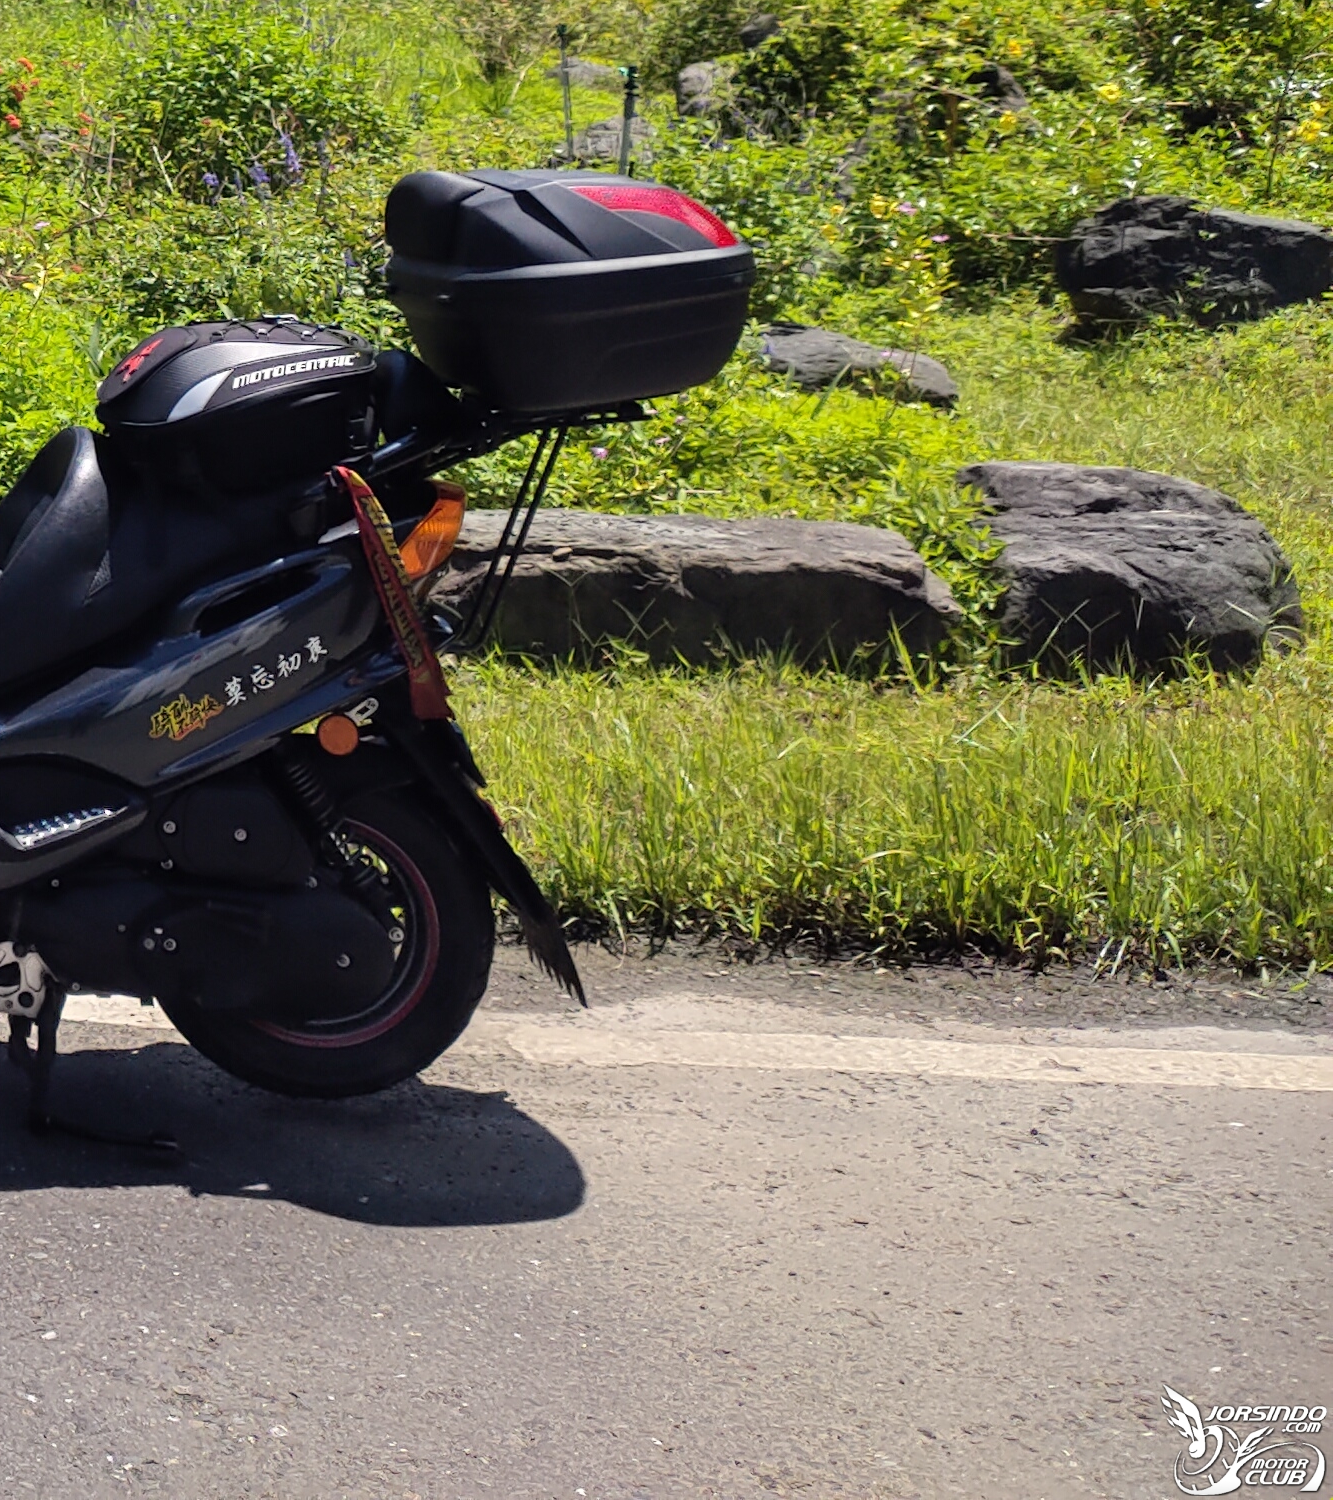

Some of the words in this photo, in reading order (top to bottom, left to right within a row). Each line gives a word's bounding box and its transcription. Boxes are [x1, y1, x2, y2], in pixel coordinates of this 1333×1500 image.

[232, 355, 355, 389] MOTOCENTRIC
[223, 635, 328, 707] 莫忘初衷
